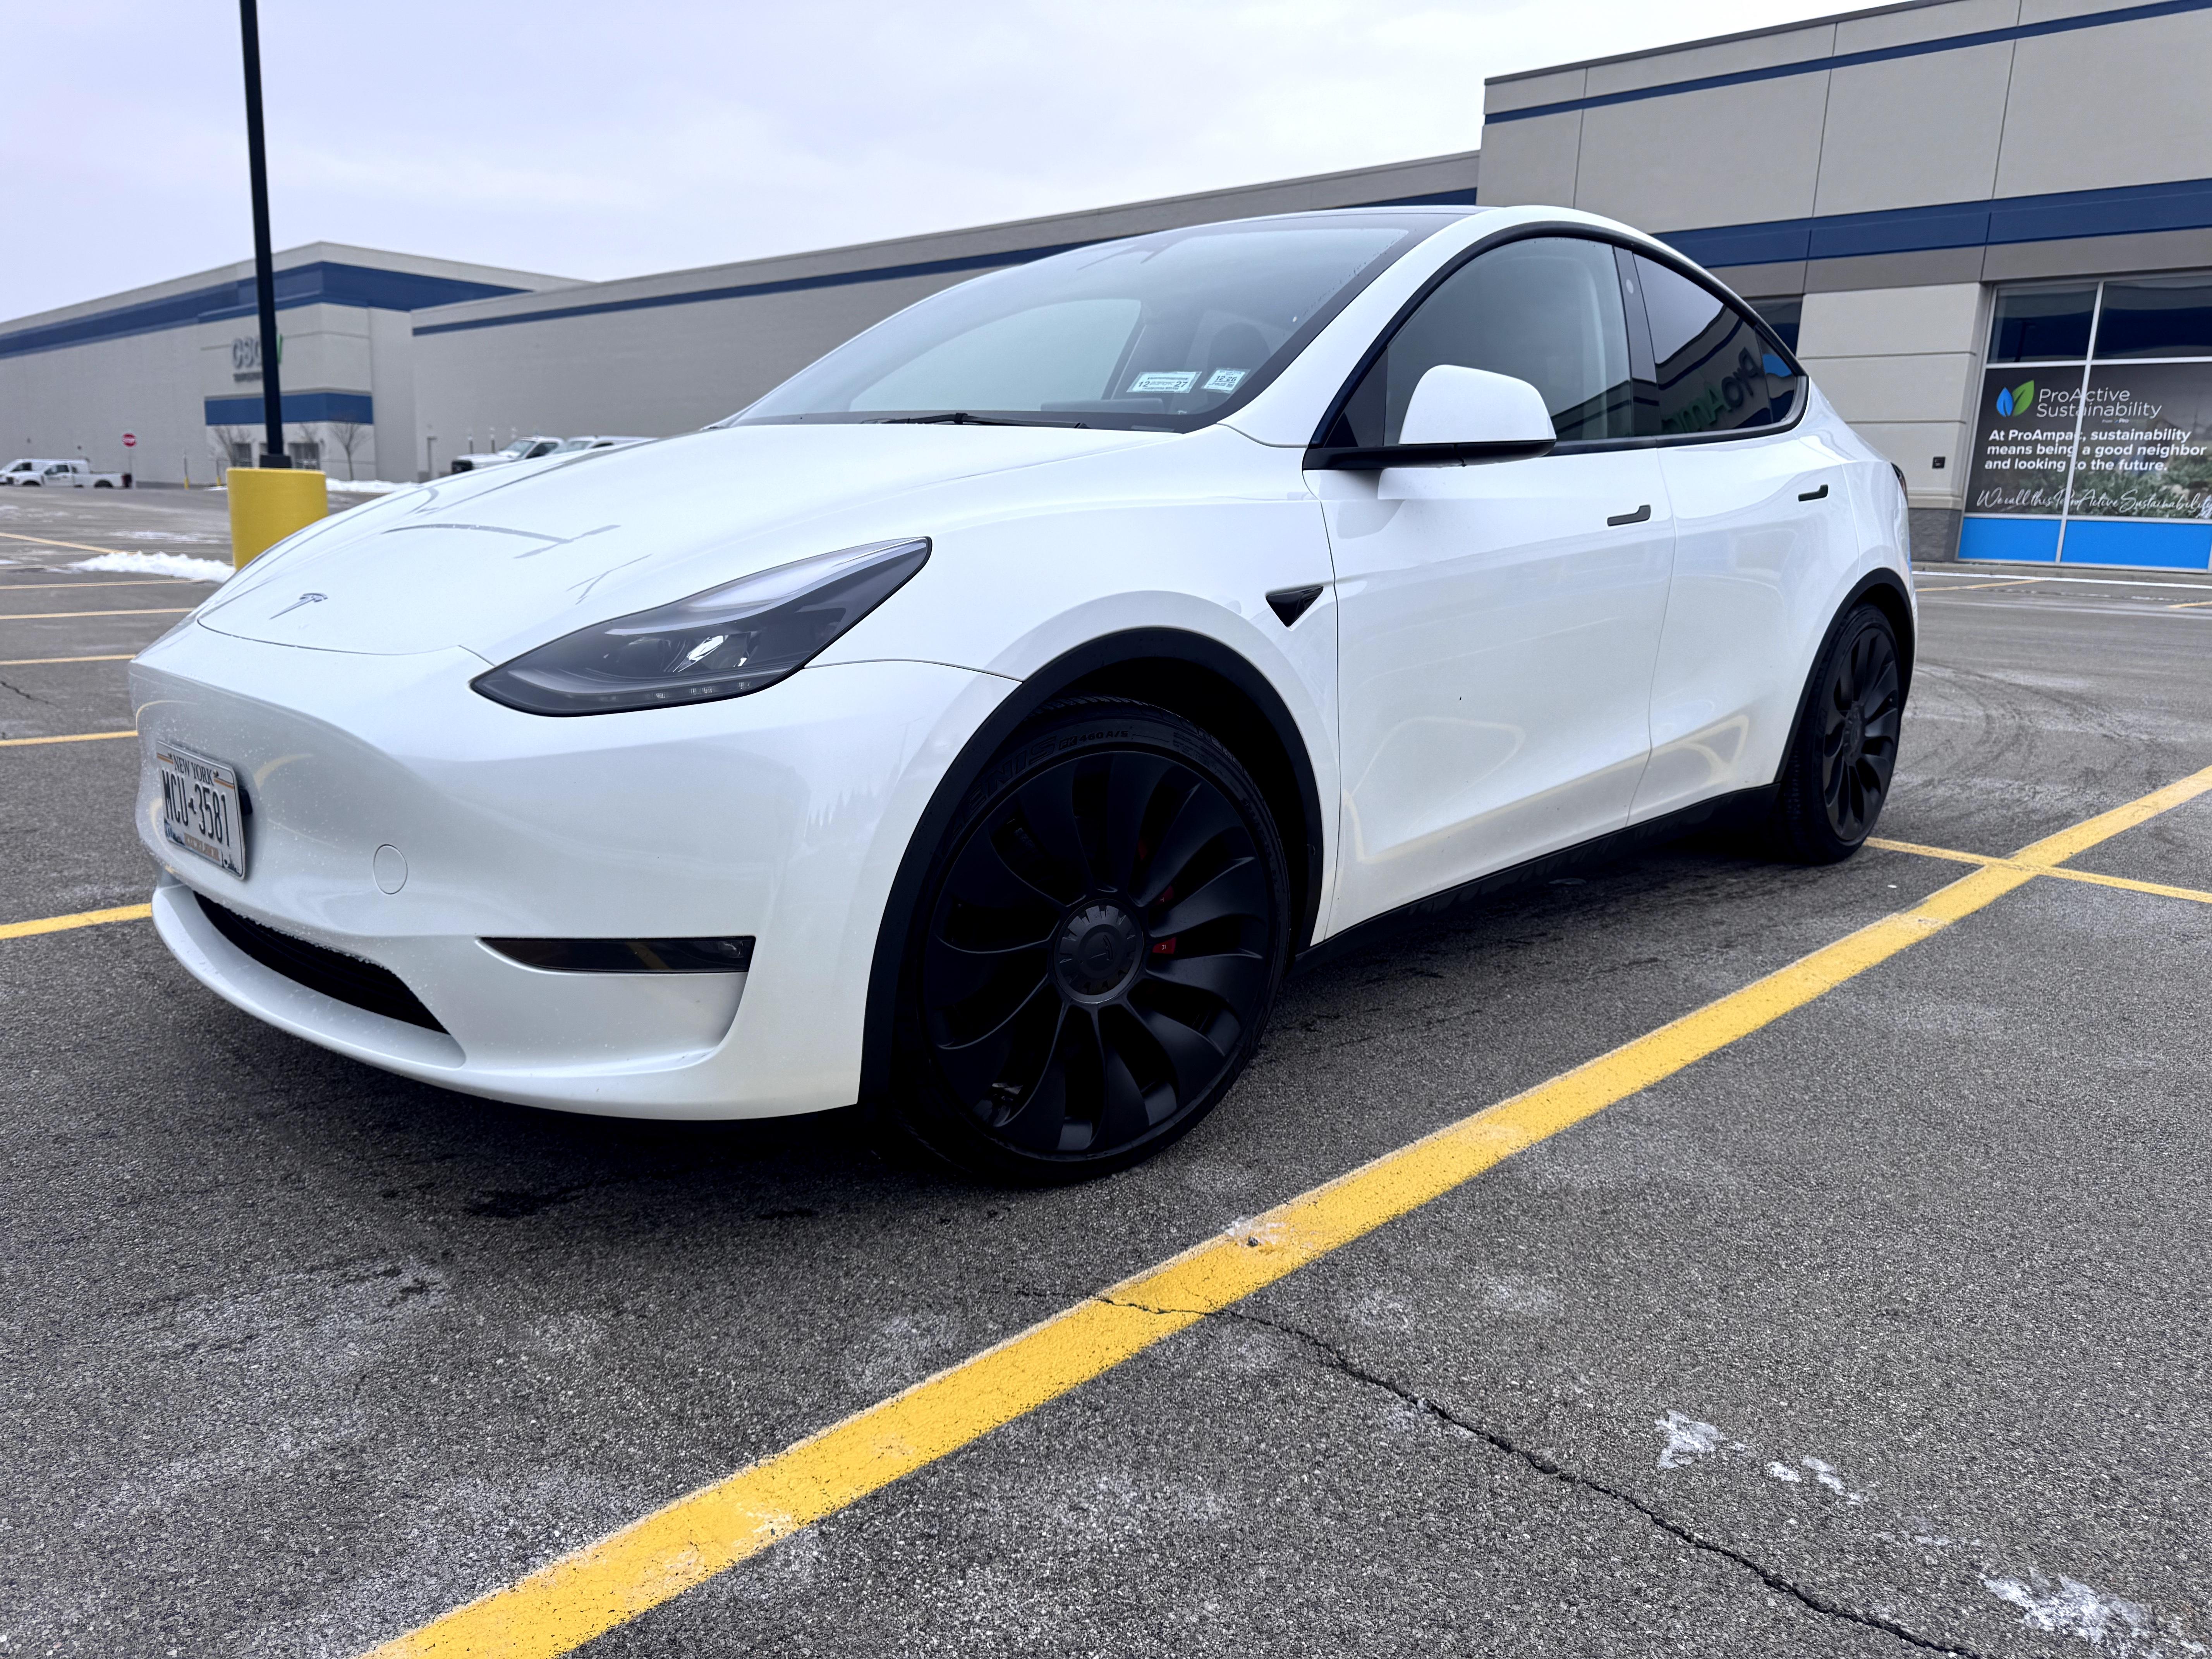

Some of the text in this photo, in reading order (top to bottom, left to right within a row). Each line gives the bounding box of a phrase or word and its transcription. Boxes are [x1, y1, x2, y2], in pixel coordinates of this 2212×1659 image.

[2039, 387, 2130, 403] ProActive
[2037, 402, 2162, 419] Sustainability
[1989, 428, 2192, 443] At ProAmpa, sustainability
[1987, 443, 2207, 459] means being a good neighbor
[1985, 458, 2011, 469] and
[2014, 458, 2066, 472] looking
[2091, 459, 2114, 471] the
[2119, 459, 2168, 471] future.
[1976, 487, 2003, 508] We
[2004, 489, 2031, 506] call
[2031, 488, 2052, 507] this
[1079, 732, 1104, 742] 460
[173, 755, 215, 786] NEW YORK
[162, 769, 189, 826] MCU
[194, 783, 230, 847] 3581
